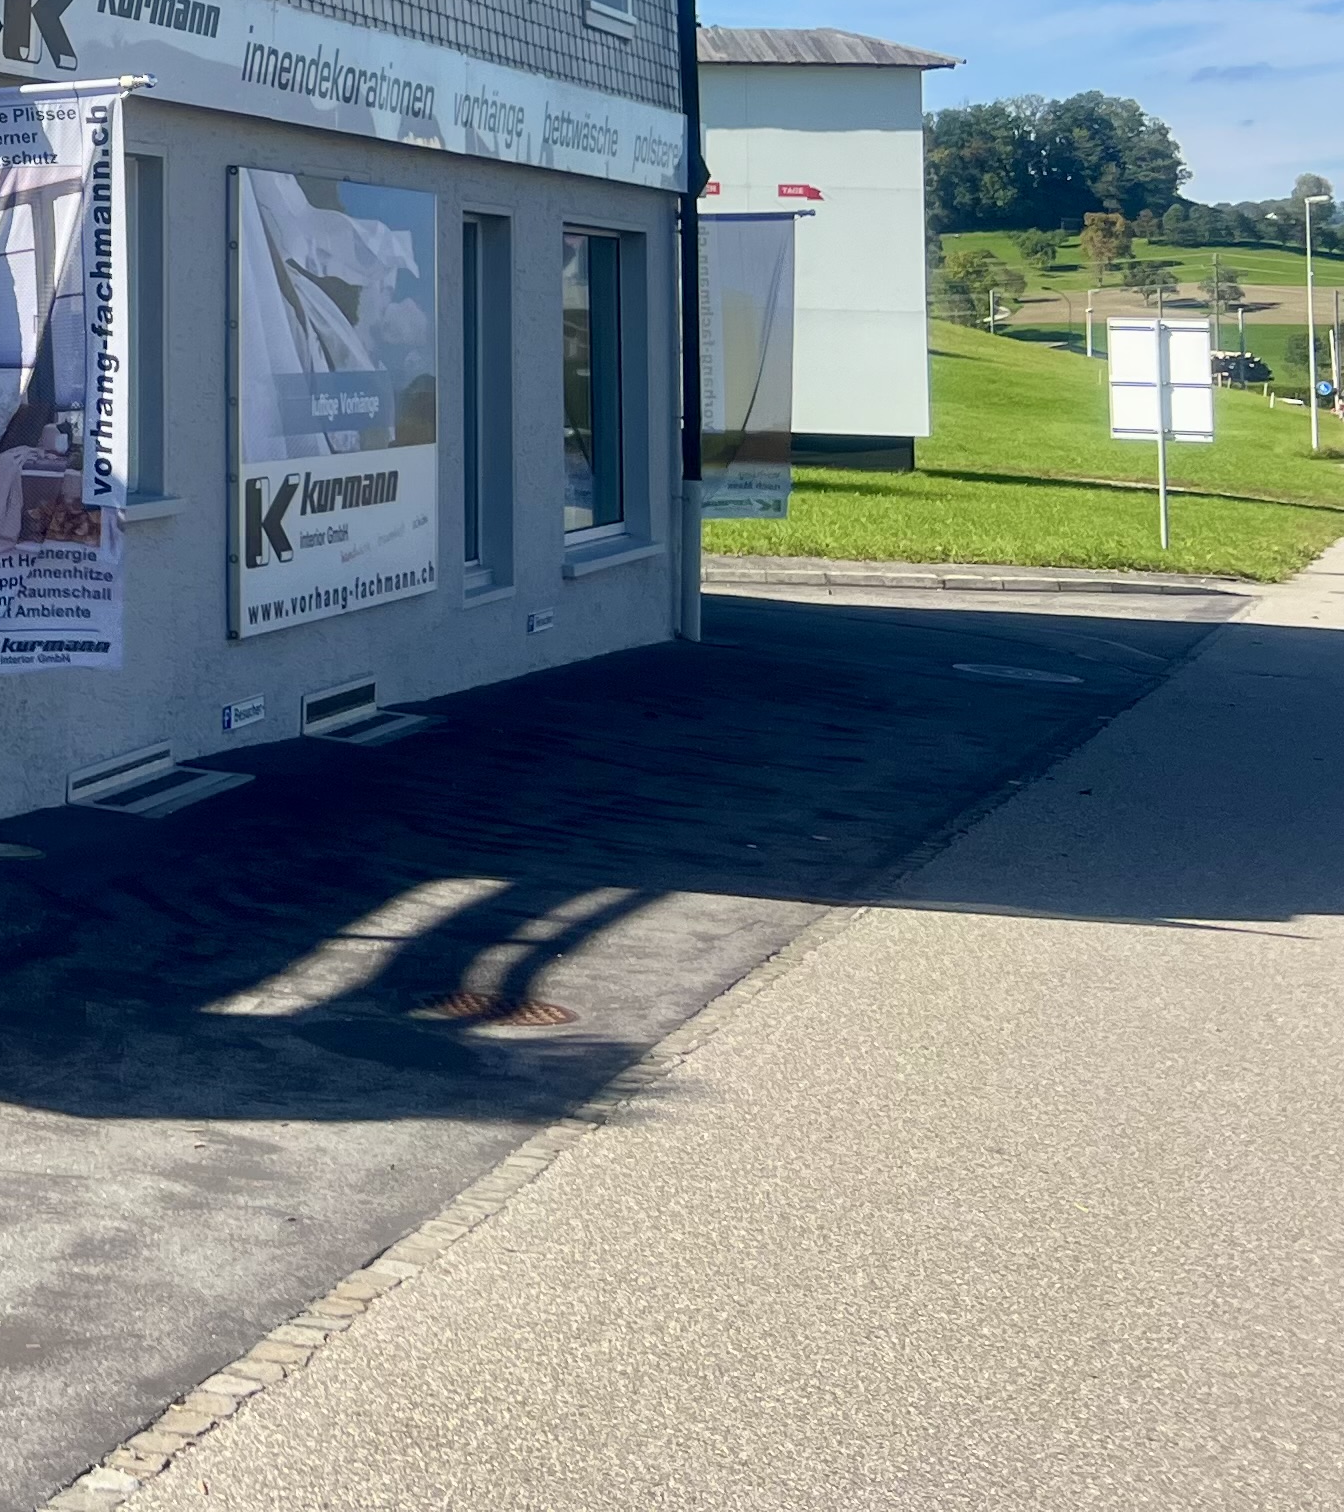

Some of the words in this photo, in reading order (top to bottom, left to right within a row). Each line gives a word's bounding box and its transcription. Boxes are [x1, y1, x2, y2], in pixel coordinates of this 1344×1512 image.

[241, 24, 435, 120] innendekorationen
[453, 85, 525, 150] vorhänge
[542, 100, 619, 158] bettwäsche
[13, 105, 77, 124] Plissée
[85, 104, 120, 496] vorhang-fachmann.ch
[300, 470, 399, 516] kurmann
[16, 604, 91, 619] Ambiente
[248, 560, 435, 625] www.vorhang-fachmann.ch
[1, 637, 111, 654] kurmann
